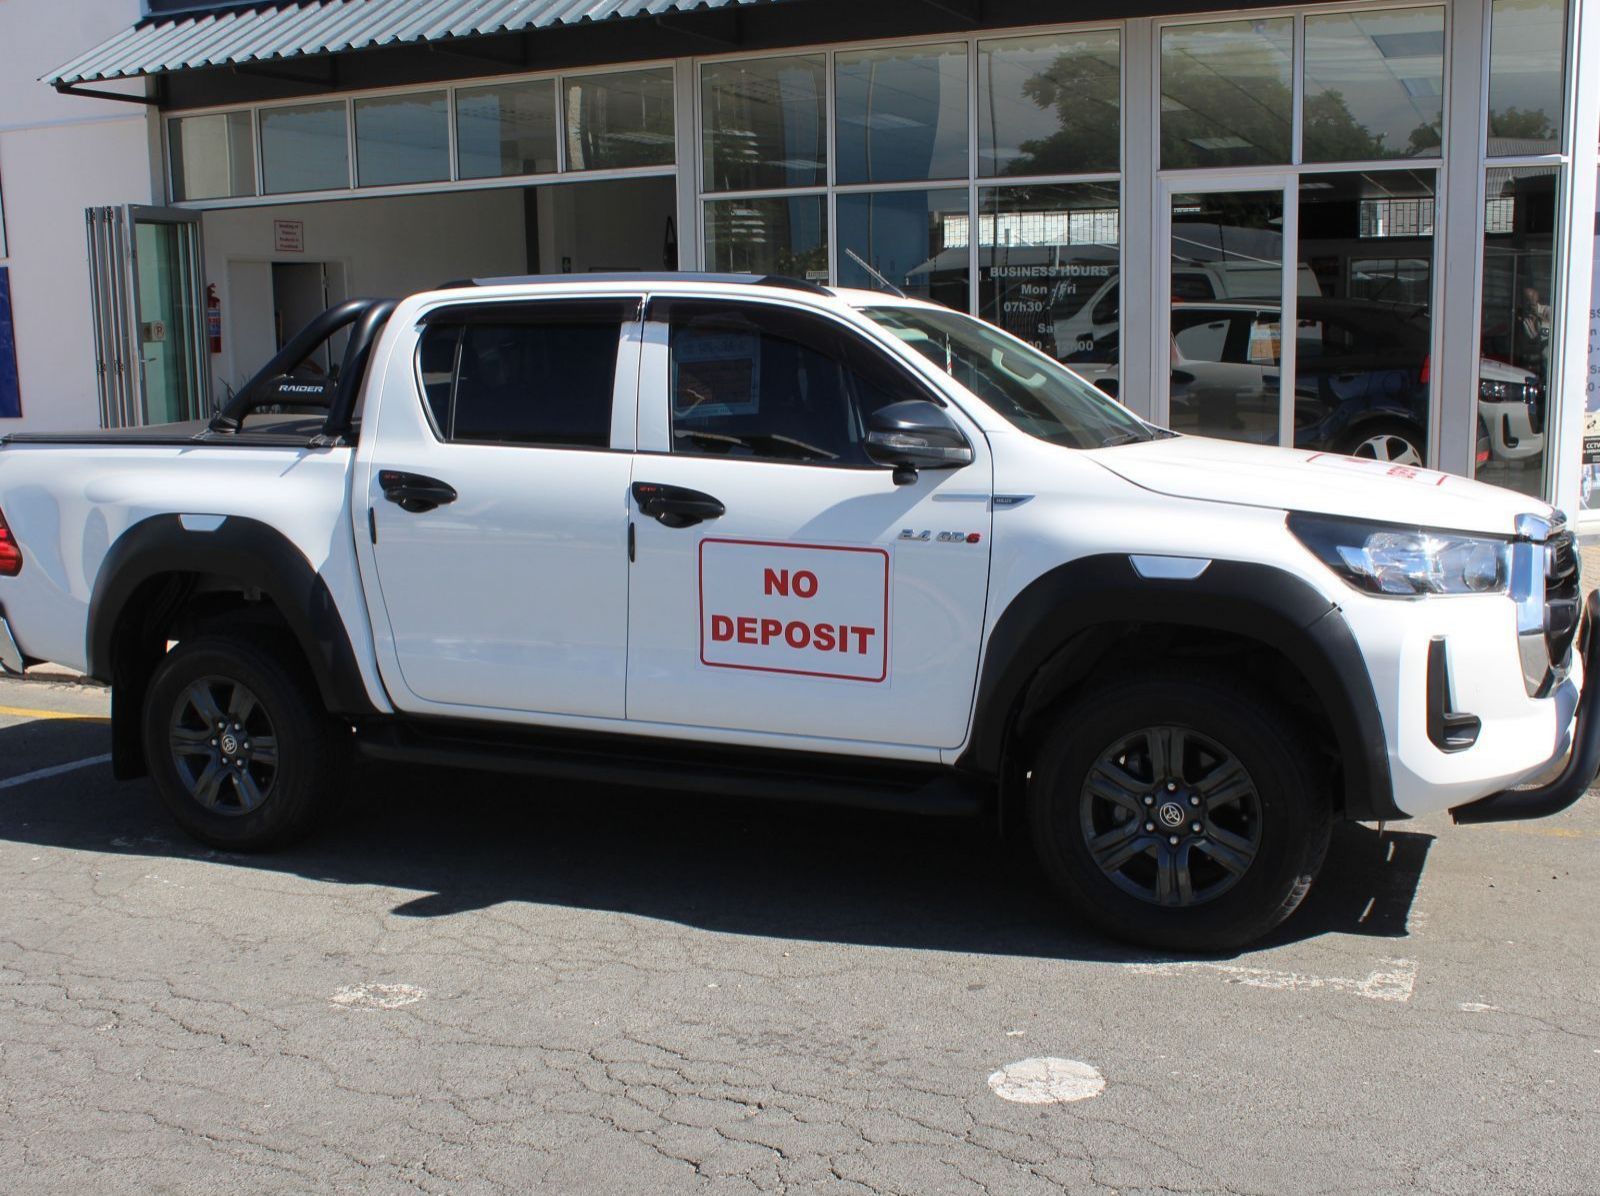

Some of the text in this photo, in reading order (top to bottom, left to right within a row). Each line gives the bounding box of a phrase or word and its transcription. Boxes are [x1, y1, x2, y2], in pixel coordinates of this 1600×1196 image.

[990, 266, 1109, 277] BUSINESS HOURS
[1021, 284, 1048, 294] Mon
[1060, 284, 1076, 294] Fri
[1003, 301, 1042, 312] 07h30
[1037, 323, 1055, 334] Sa
[279, 384, 324, 393] RAIDER
[764, 568, 818, 598] NO
[711, 614, 875, 655] DEPOSIT
